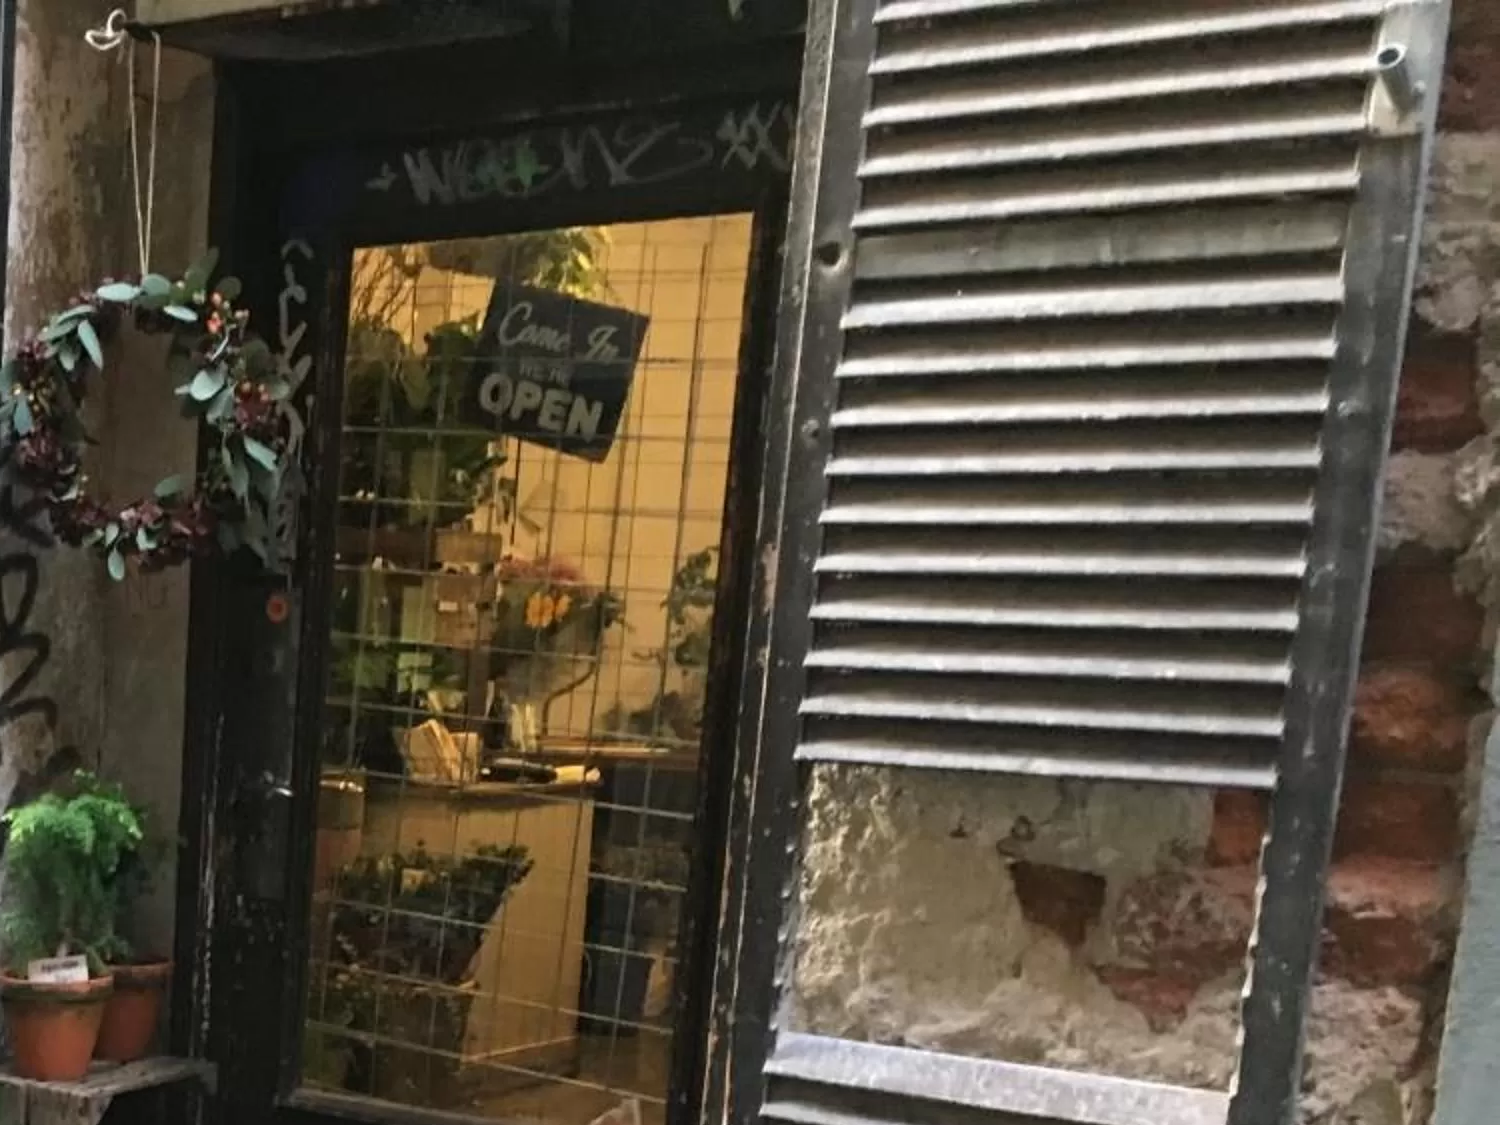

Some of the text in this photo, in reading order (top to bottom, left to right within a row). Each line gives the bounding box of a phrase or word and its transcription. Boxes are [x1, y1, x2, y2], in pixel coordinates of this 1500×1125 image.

[498, 302, 621, 364] Come In
[479, 371, 604, 443] OPEN
